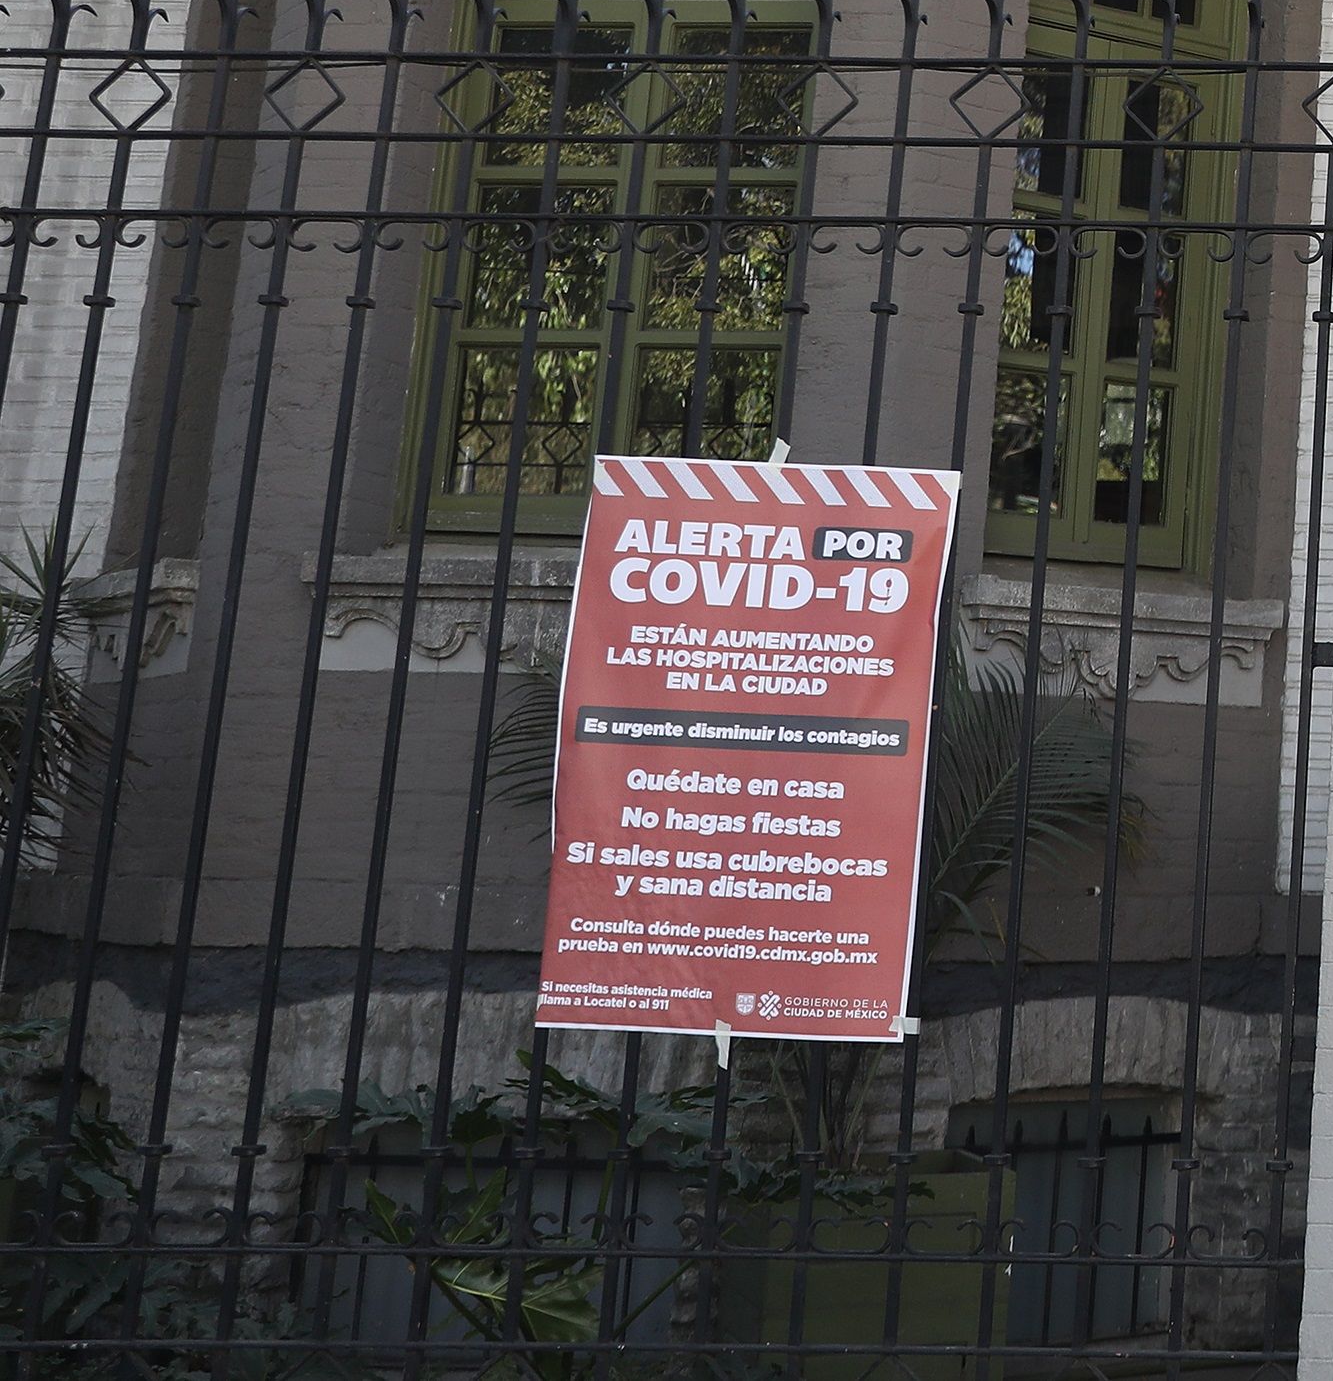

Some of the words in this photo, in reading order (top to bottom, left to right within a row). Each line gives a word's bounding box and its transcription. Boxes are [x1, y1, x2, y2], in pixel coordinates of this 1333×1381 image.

[614, 519, 806, 561] ALERTA
[822, 529, 903, 559] POR
[609, 557, 909, 613] COVID-19
[630, 624, 708, 647] ESTÁN
[712, 628, 875, 654] AUMENTANDO
[606, 646, 652, 666] LAS
[656, 647, 895, 677] HOSPITALIZACIONES
[666, 671, 700, 691] EN
[705, 673, 736, 692] LA
[741, 675, 828, 696] CIUDAD
[583, 717, 607, 735] Es
[611, 720, 684, 740] urgente
[688, 722, 775, 742] disminuir
[778, 725, 804, 743] los
[807, 727, 900, 747] contagios
[626, 768, 741, 797] Quédate
[747, 775, 779, 798] en
[783, 778, 845, 800] casa
[621, 807, 659, 828] No
[666, 808, 747, 837] hagas
[752, 812, 841, 837] fiestas
[566, 843, 595, 864] Si
[600, 844, 670, 867] sales
[675, 849, 723, 871] usa
[727, 848, 888, 877] cubrebocas
[615, 875, 633, 897] y
[639, 875, 704, 897] sana
[709, 876, 832, 902] distancia
[571, 917, 644, 934] Consulta
[647, 920, 701, 938] dónde
[705, 925, 764, 943] puedes
[769, 926, 833, 943] hacerte
[837, 932, 869, 945] una
[558, 937, 619, 955] prueba
[623, 941, 644, 954] en
[647, 943, 877, 965] www.covid19.cdmx.gob.mx
[541, 981, 552, 992] Si
[556, 982, 608, 994] necesitas
[611, 985, 668, 997] asistencia
[672, 987, 712, 1000] médica
[574, 996, 581, 1006] a
[582, 995, 626, 1008] Locatel
[629, 999, 637, 1009] o
[640, 998, 650, 1009] al
[653, 998, 670, 1010] 911
[785, 996, 848, 1008] GOBIERNO
[853, 998, 869, 1008] DE
[873, 1000, 889, 1009] LA
[784, 1008, 824, 1018] CIUDAD
[829, 1008, 843, 1019] DE
[846, 1008, 888, 1019] MÉXICO
